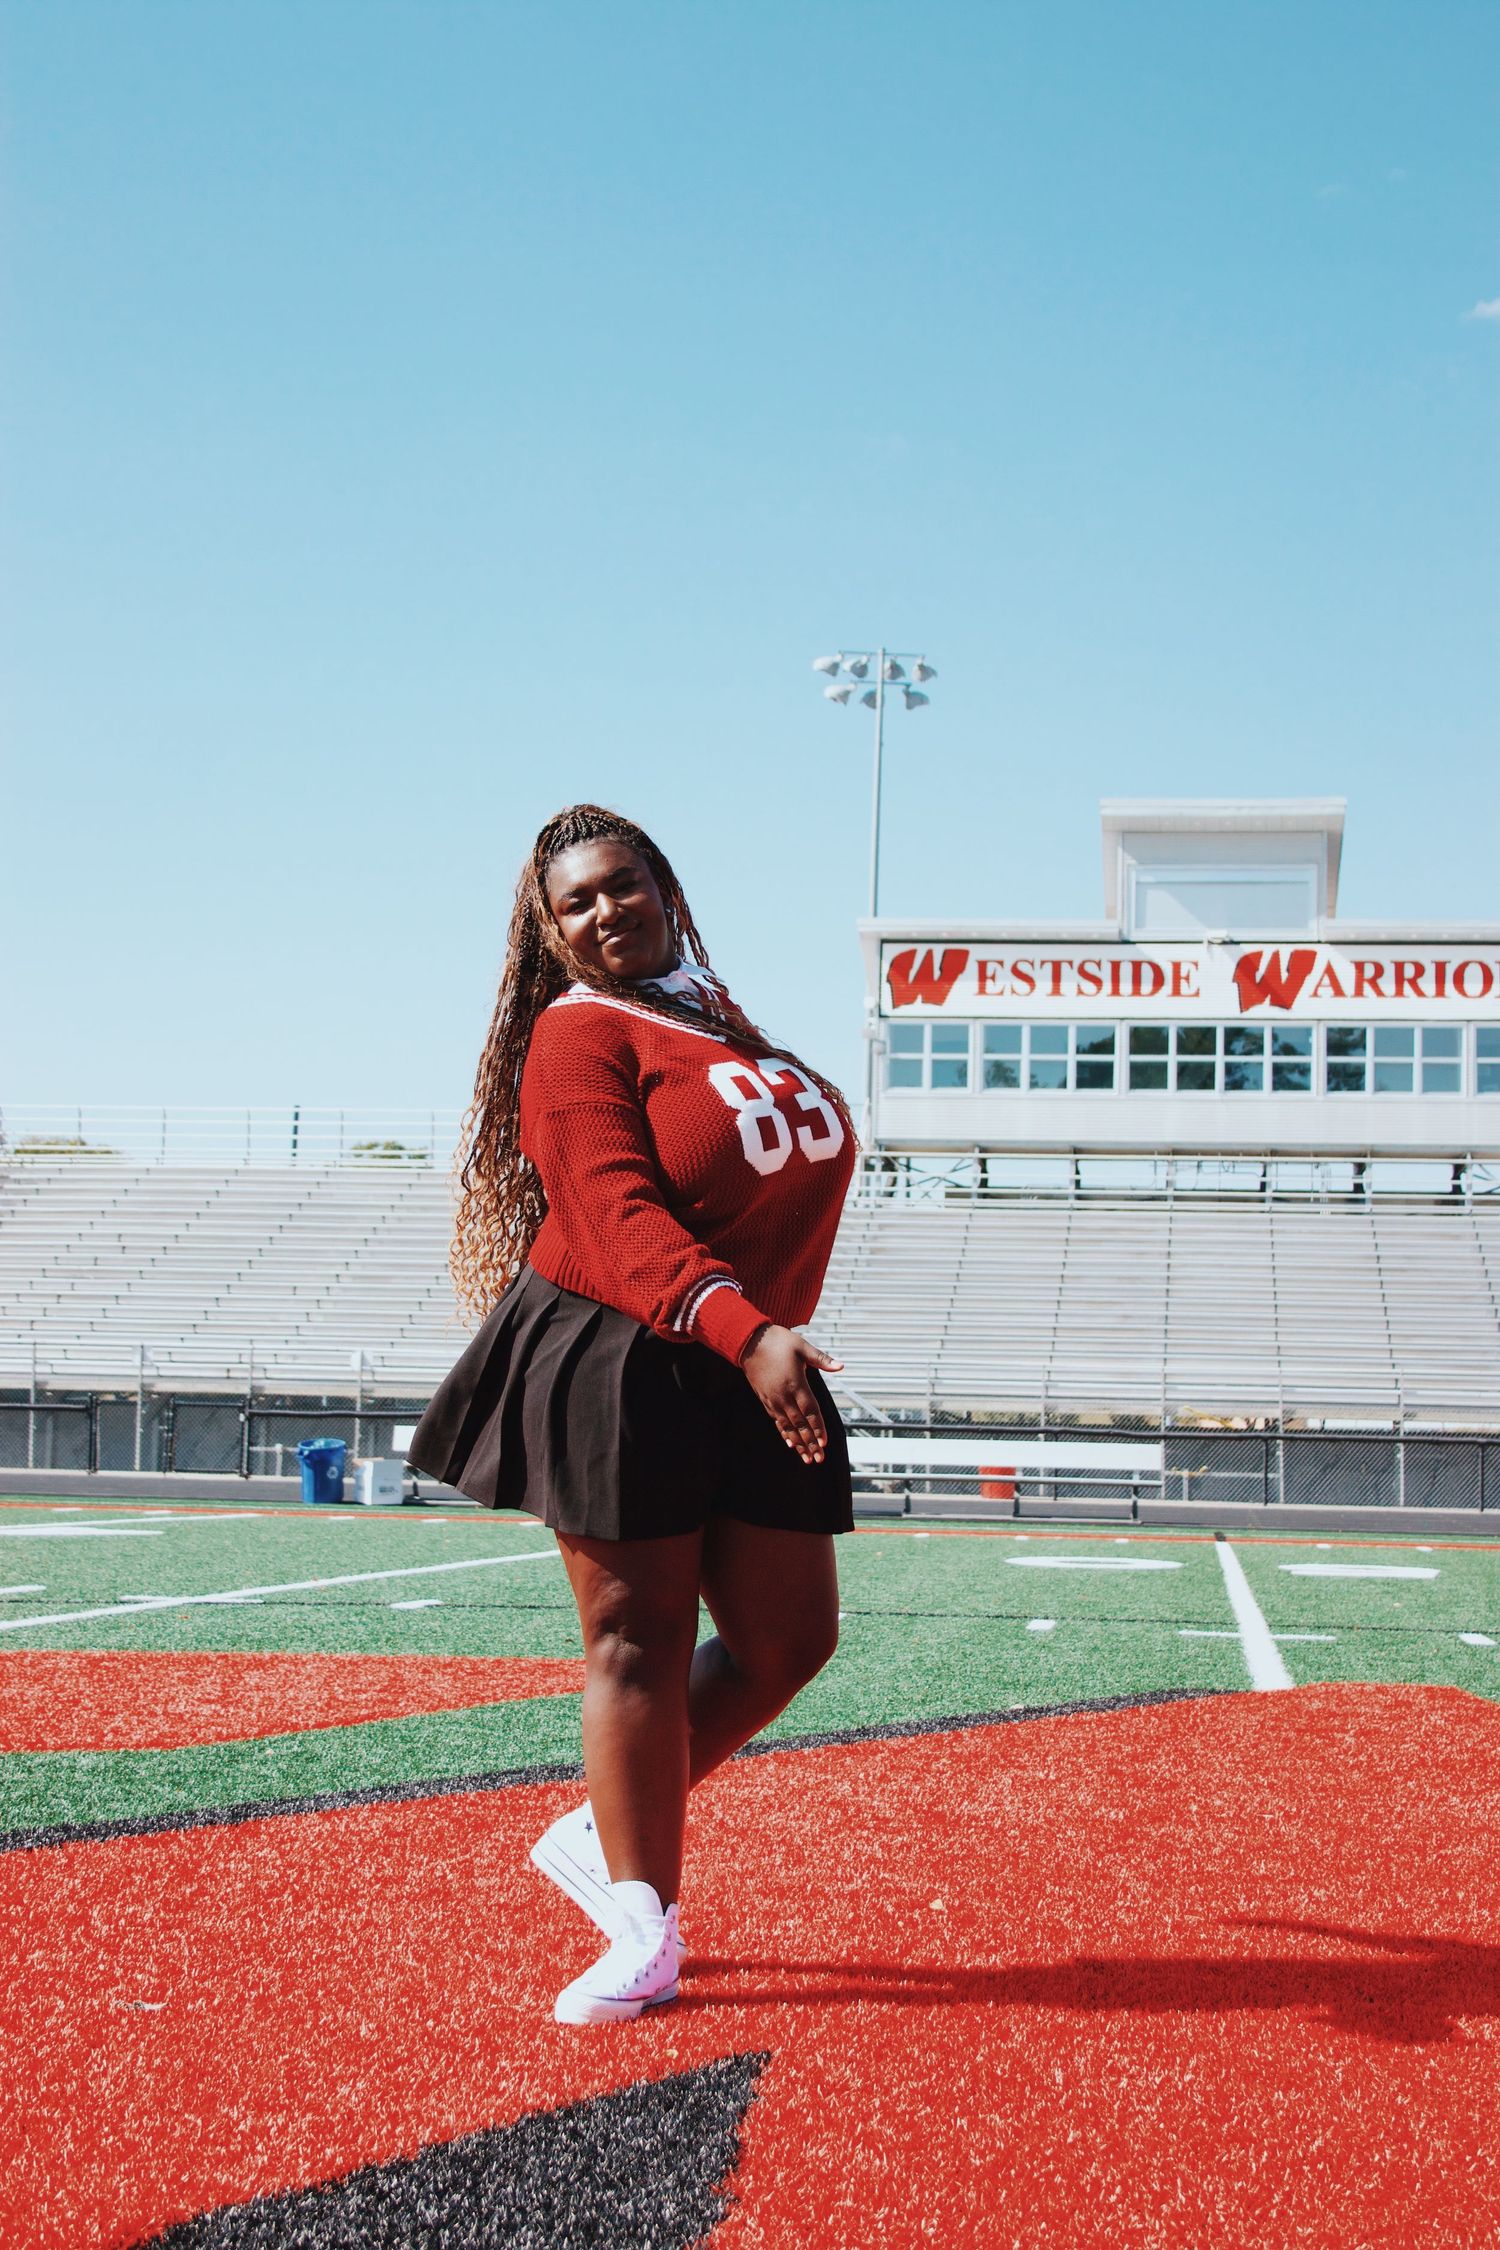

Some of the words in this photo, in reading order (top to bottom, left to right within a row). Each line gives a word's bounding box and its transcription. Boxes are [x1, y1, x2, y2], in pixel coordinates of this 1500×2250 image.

[886, 948, 1201, 1010] WESTSIDE
[1232, 948, 1500, 1014] WARRIO
[708, 1057, 845, 1177] 83
